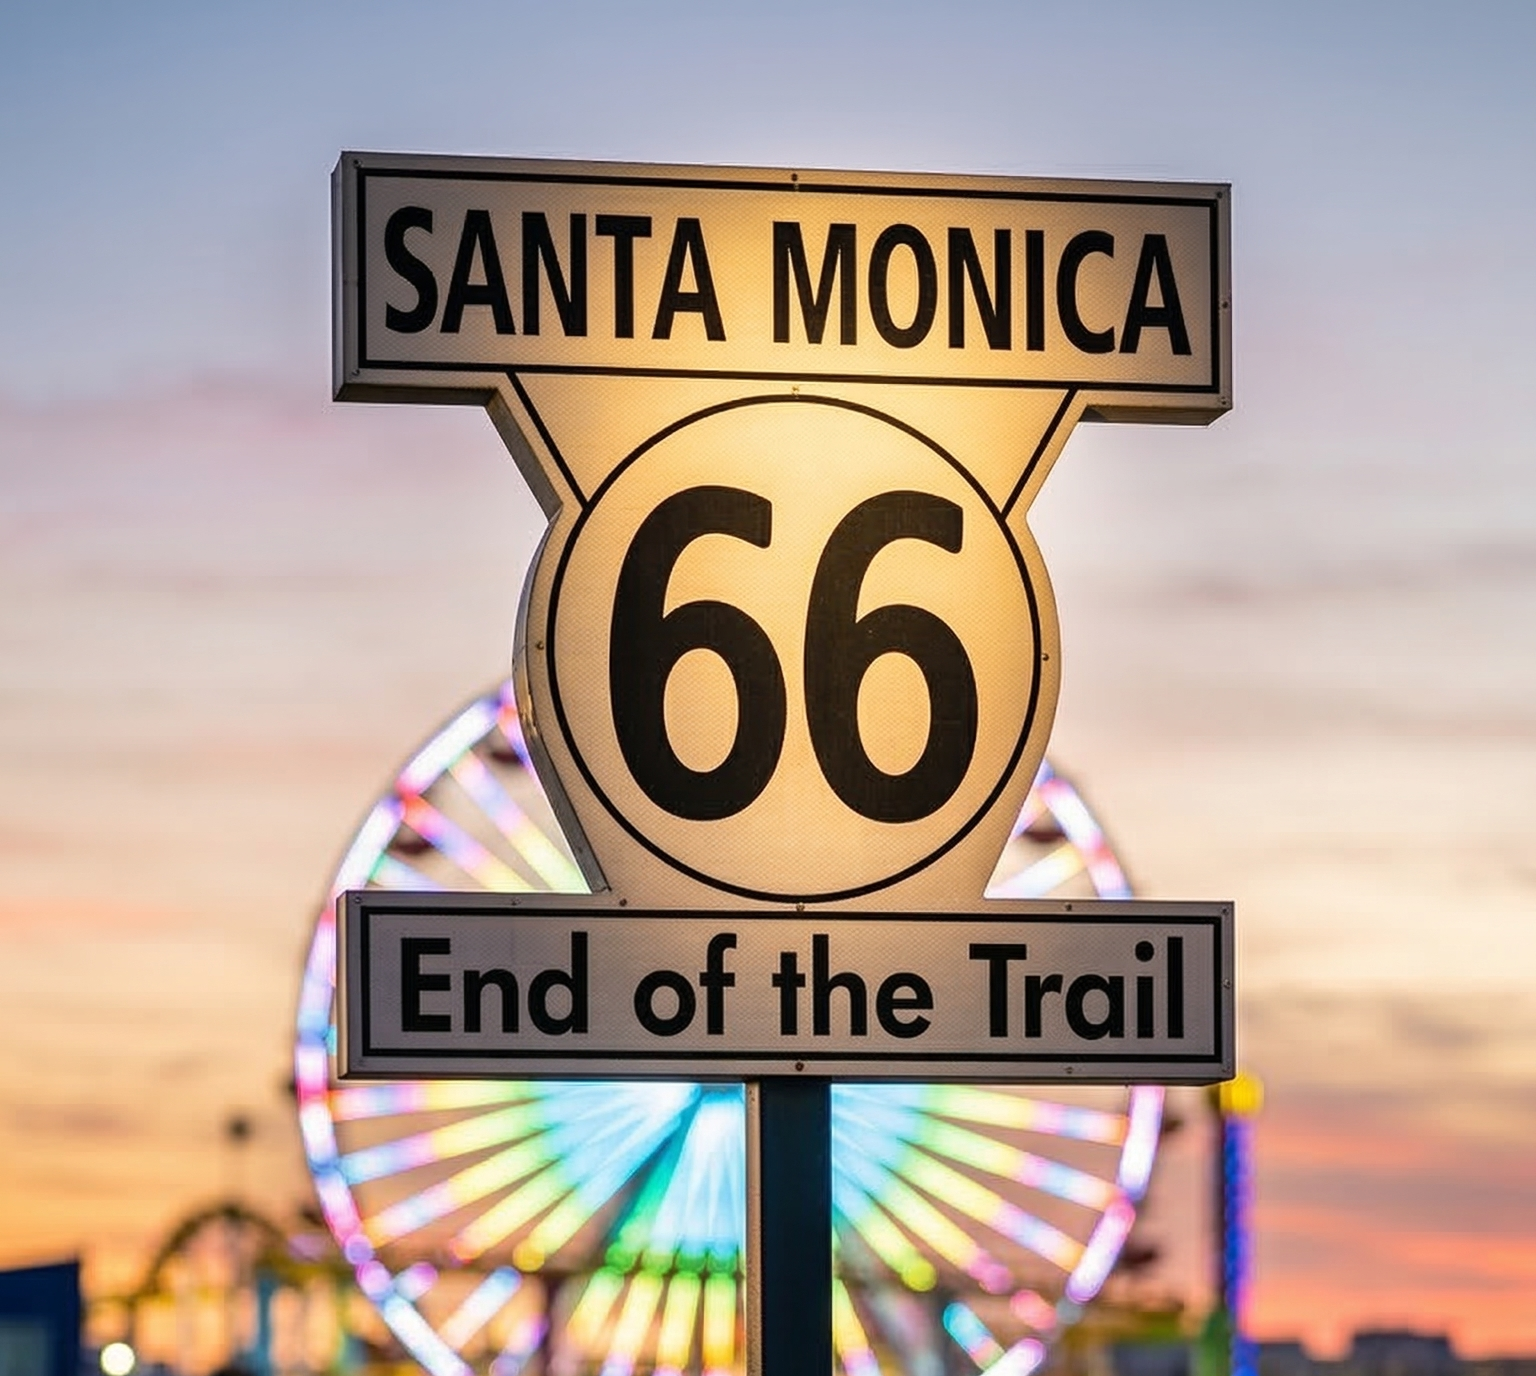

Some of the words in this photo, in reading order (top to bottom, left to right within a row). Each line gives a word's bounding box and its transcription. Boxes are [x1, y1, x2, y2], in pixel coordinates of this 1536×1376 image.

[384, 205, 726, 342] SANTA
[772, 220, 1192, 357] MONICA
[608, 484, 979, 825] 66
[401, 930, 588, 1036] End
[633, 932, 737, 1037] of
[772, 933, 935, 1038] the
[969, 935, 1184, 1041] Trail
